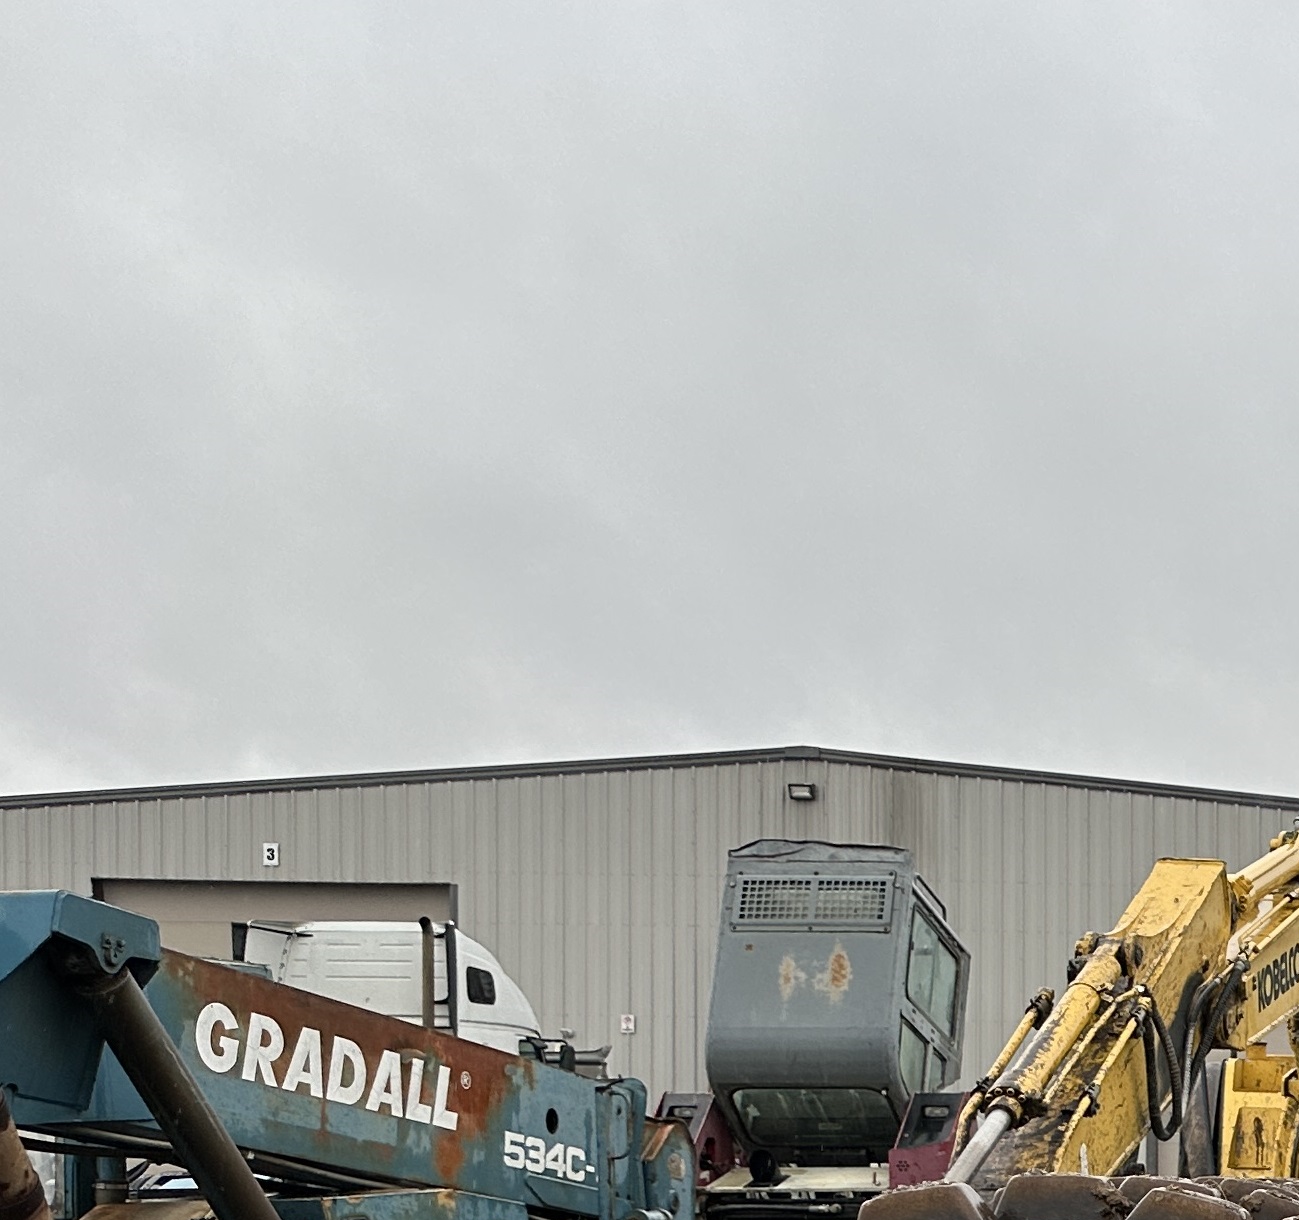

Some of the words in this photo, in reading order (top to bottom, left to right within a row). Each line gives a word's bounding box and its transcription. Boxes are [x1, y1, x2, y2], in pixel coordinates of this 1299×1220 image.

[266, 847, 275, 861] 3
[195, 1002, 459, 1131] GRADALL
[503, 1130, 599, 1183] 534C-
